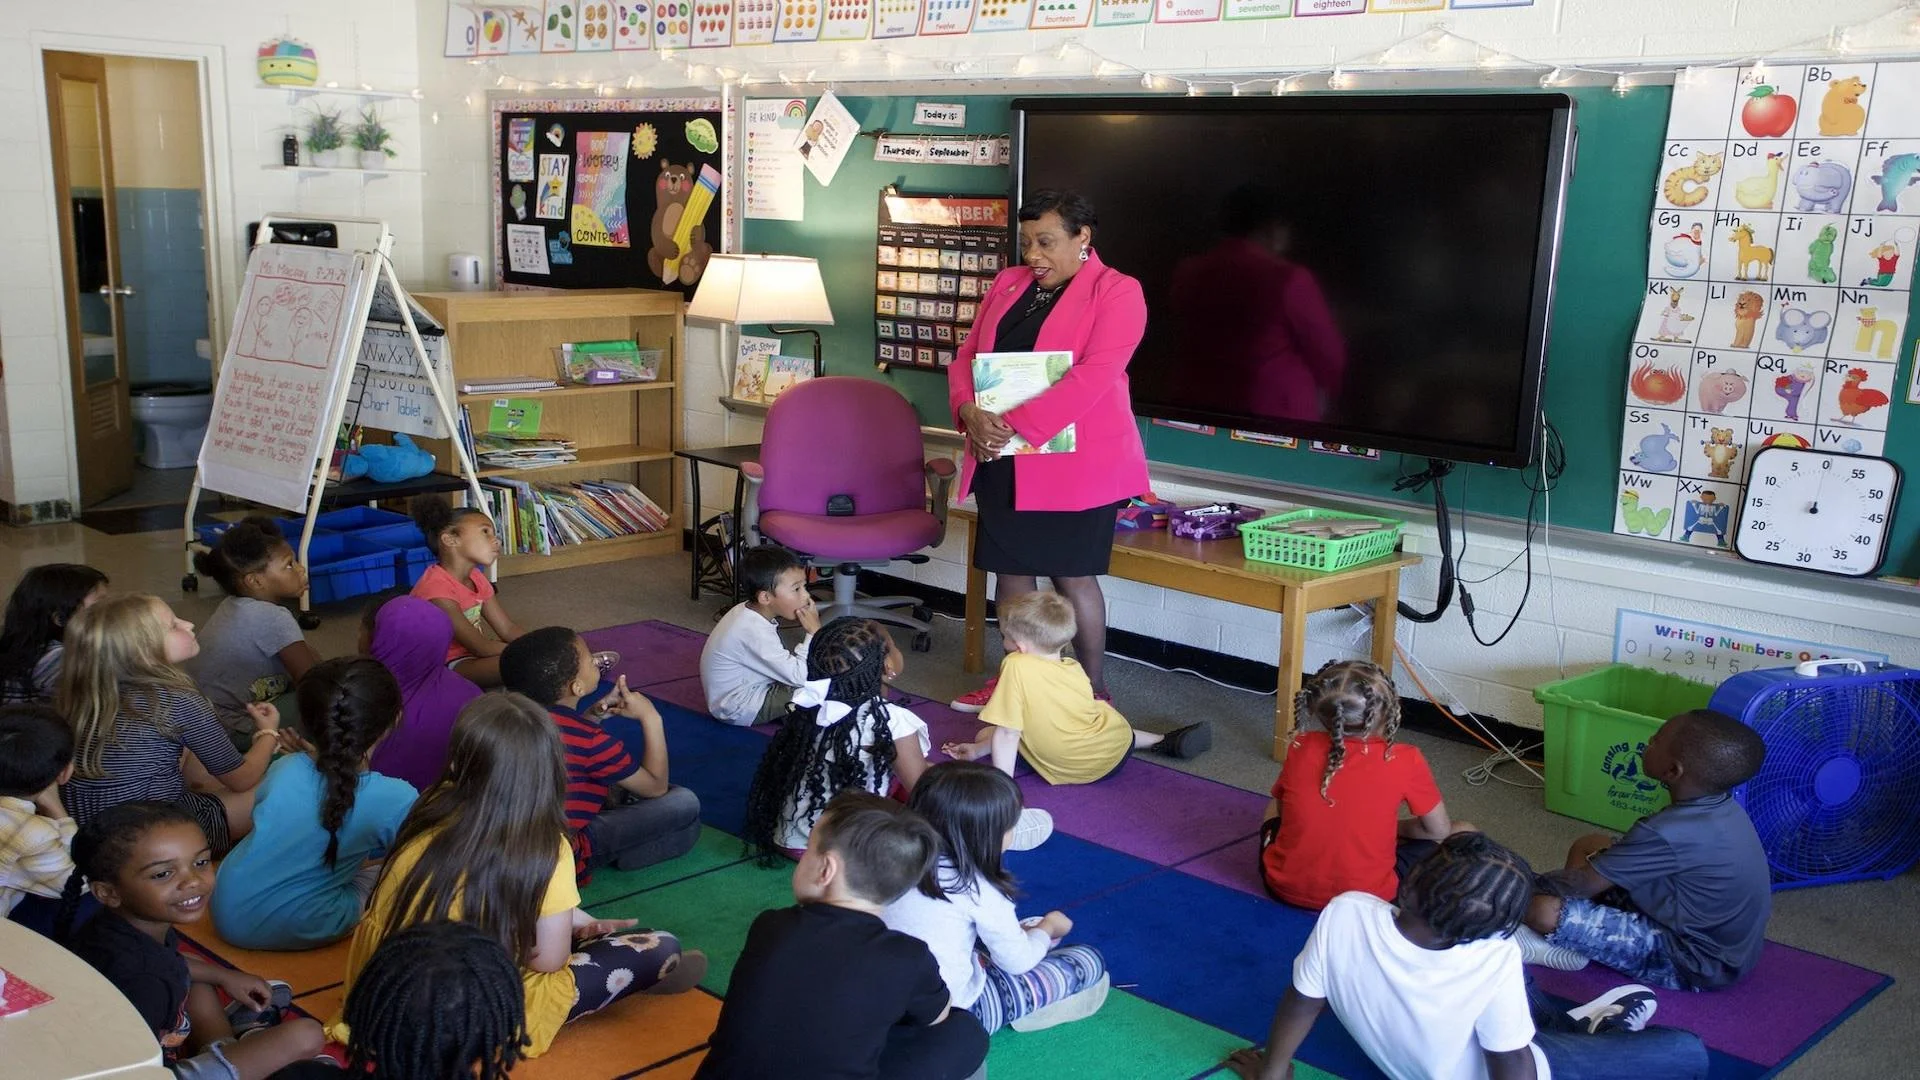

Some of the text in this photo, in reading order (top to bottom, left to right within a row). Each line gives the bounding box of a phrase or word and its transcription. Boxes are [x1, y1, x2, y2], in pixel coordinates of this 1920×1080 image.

[1239, 4, 1280, 13] seventeen
[1313, 0, 1351, 10] eighteen
[1112, 11, 1135, 19] fifteen
[1176, 8, 1204, 16] sixteen
[466, 25, 475, 45] 0
[1808, 67, 1832, 82] Bb
[760, 112, 776, 122] KIND
[923, 109, 947, 121] Today
[929, 146, 970, 158] September
[1001, 146, 1009, 156] 20
[1668, 141, 1889, 157] Cc Dd Ee Ff
[541, 156, 567, 177] STAY
[583, 154, 619, 171] WORRY
[1658, 211, 1873, 237] Gg Hh Ii Jj
[576, 228, 623, 244] CONTROL
[967, 257, 973, 265] 5
[987, 258, 993, 267] 6
[1649, 281, 1868, 304] Kk Ll Mm Nn
[902, 302, 912, 311] 16
[922, 305, 932, 313] 17
[941, 306, 951, 315] 18
[961, 308, 971, 316] 19
[881, 325, 891, 333] 22
[900, 327, 910, 335] 23
[920, 329, 929, 337] 24
[938, 328, 948, 337] 25
[741, 342, 777, 356] Best Story
[882, 347, 930, 360] 29 30 31
[362, 343, 385, 362] Ww
[388, 345, 403, 365] Xx
[406, 346, 423, 375] Yy
[1635, 345, 1849, 374] Oo Pp Qq Rr
[362, 391, 422, 416] Chart Tablet
[1629, 410, 1842, 444] Ss Tt Uu Vv
[1791, 461, 1799, 473] 5
[1822, 459, 1830, 471] 0
[1851, 469, 1866, 480] 55
[1622, 473, 1703, 494] Ww Xx
[1765, 476, 1777, 487] 10
[1869, 489, 1884, 500] 50
[1751, 497, 1763, 508] 15
[1868, 512, 1884, 524] 45
[1751, 520, 1766, 531] 20
[1765, 540, 1780, 552] 25
[1855, 534, 1871, 546] 40
[1796, 552, 1812, 563] 30
[1832, 549, 1848, 561] 35
[1655, 624, 1715, 648] Writing
[1719, 636, 1793, 661] Numbers
[1625, 639, 1739, 674] 0 1 2 3 4 5
[1600, 742, 1630, 775] Lansing
